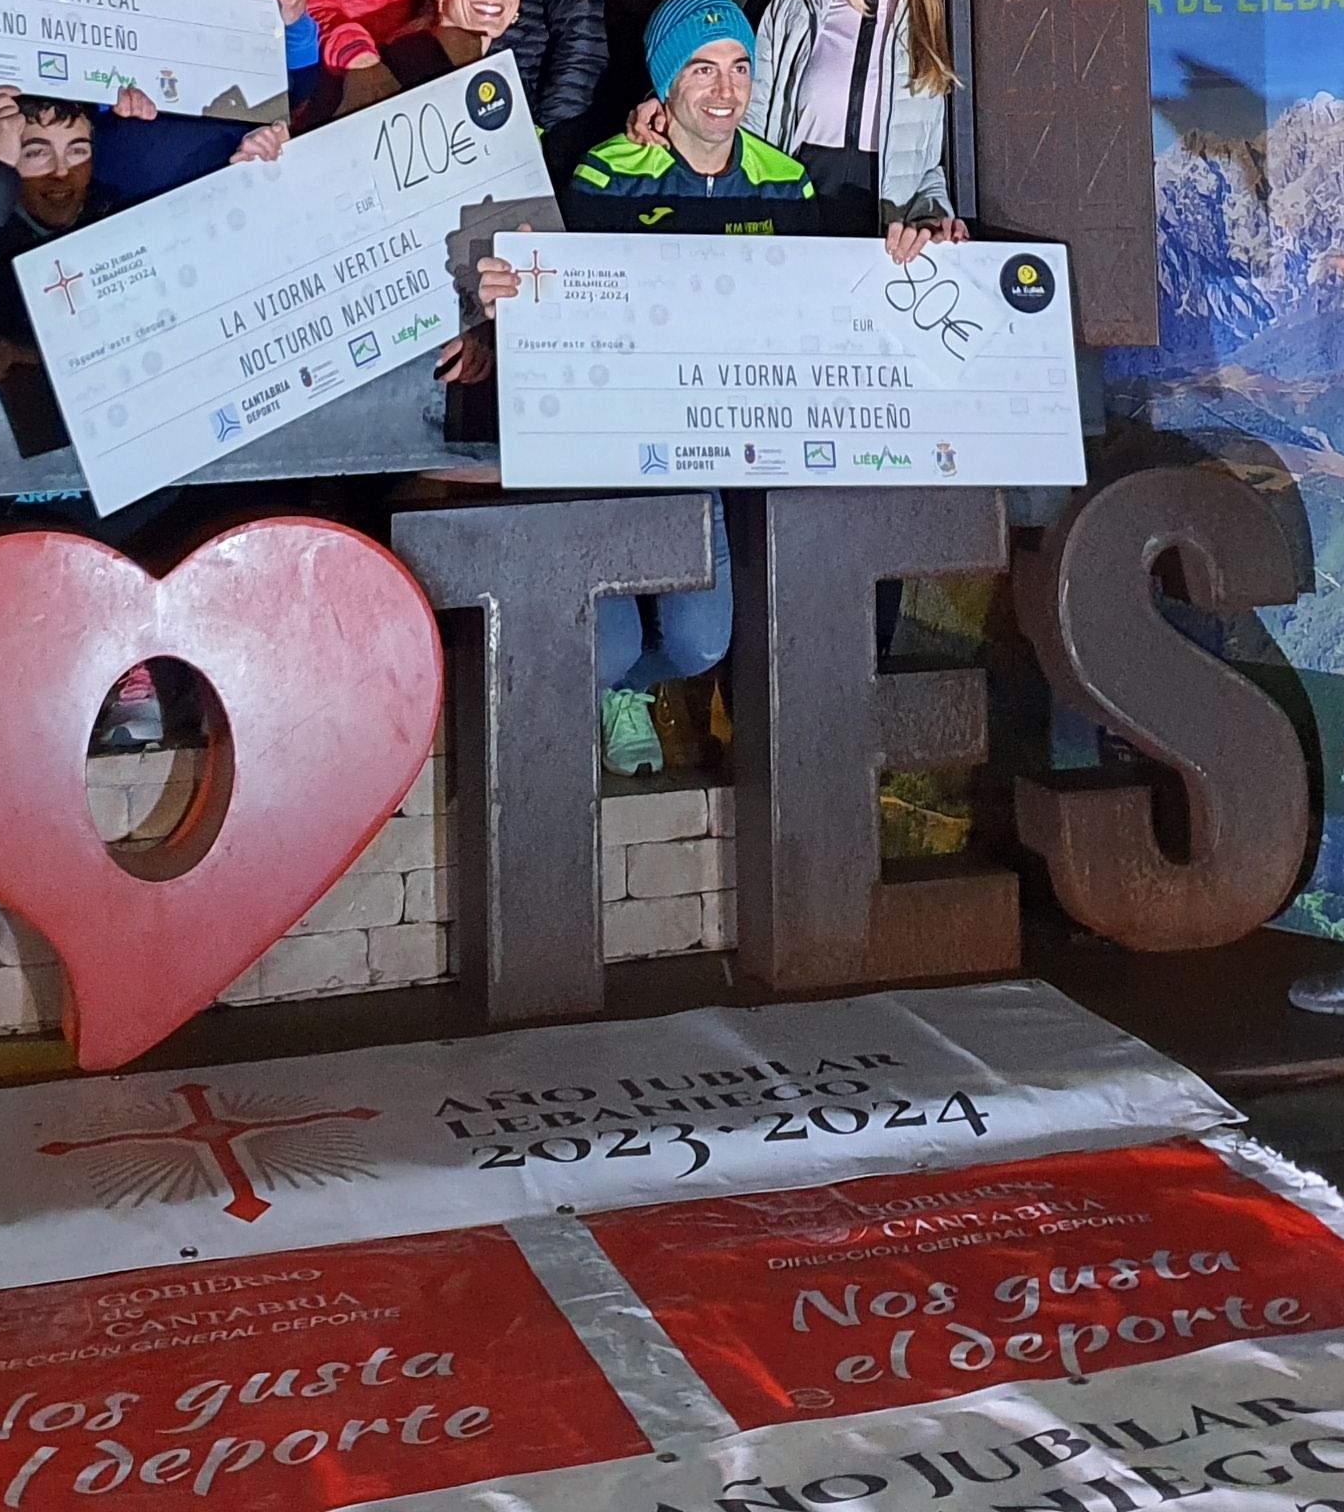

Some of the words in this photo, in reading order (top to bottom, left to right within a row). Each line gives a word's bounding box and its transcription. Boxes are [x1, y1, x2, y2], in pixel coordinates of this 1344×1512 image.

[41, 17, 138, 51] NAVIDEÑO
[356, 196, 375, 214] EUR
[91, 259, 143, 287] LEBANIEGO
[110, 246, 147, 268] JUBILAR
[587, 268, 627, 279] JUBILAR
[220, 310, 246, 339] LA
[254, 273, 326, 322] VIORNA
[333, 228, 422, 284] VERTICAL
[563, 279, 619, 288] LEBANIEGO
[239, 315, 334, 378] NOCTURNO
[341, 268, 431, 328] NAVIDEÑO
[853, 319, 873, 332] EUR
[678, 364, 704, 386] LA
[718, 364, 797, 387] VIORNA
[811, 365, 914, 388] VERTICAL
[241, 379, 291, 412] CANTABRIA
[246, 400, 281, 425] DEPORTE
[686, 406, 793, 429] NOCTURNO
[807, 403, 912, 429] NAVIDEÑO
[675, 445, 731, 458] CANTABRIA
[676, 459, 715, 471] DEPORTE
[434, 1087, 596, 1119] AÑO
[617, 1053, 904, 1102] JUBILAR
[445, 1078, 870, 1140] LEBANIEGO
[1040, 1210, 1155, 1235] DEPORTE
[97, 1268, 323, 1310] GOBIERNO
[791, 1279, 959, 1333] Nos
[994, 1244, 1242, 1324] gusta
[105, 1289, 362, 1341] CANTABRIA
[129, 1324, 258, 1356] GENERAL
[271, 1304, 402, 1334] DEPORTE
[834, 1328, 916, 1384] el
[946, 1290, 1312, 1380] deporte
[156, 1345, 455, 1434] gusta
[72, 1401, 494, 1498] deporte
[900, 1396, 1324, 1500] JUBILAR
